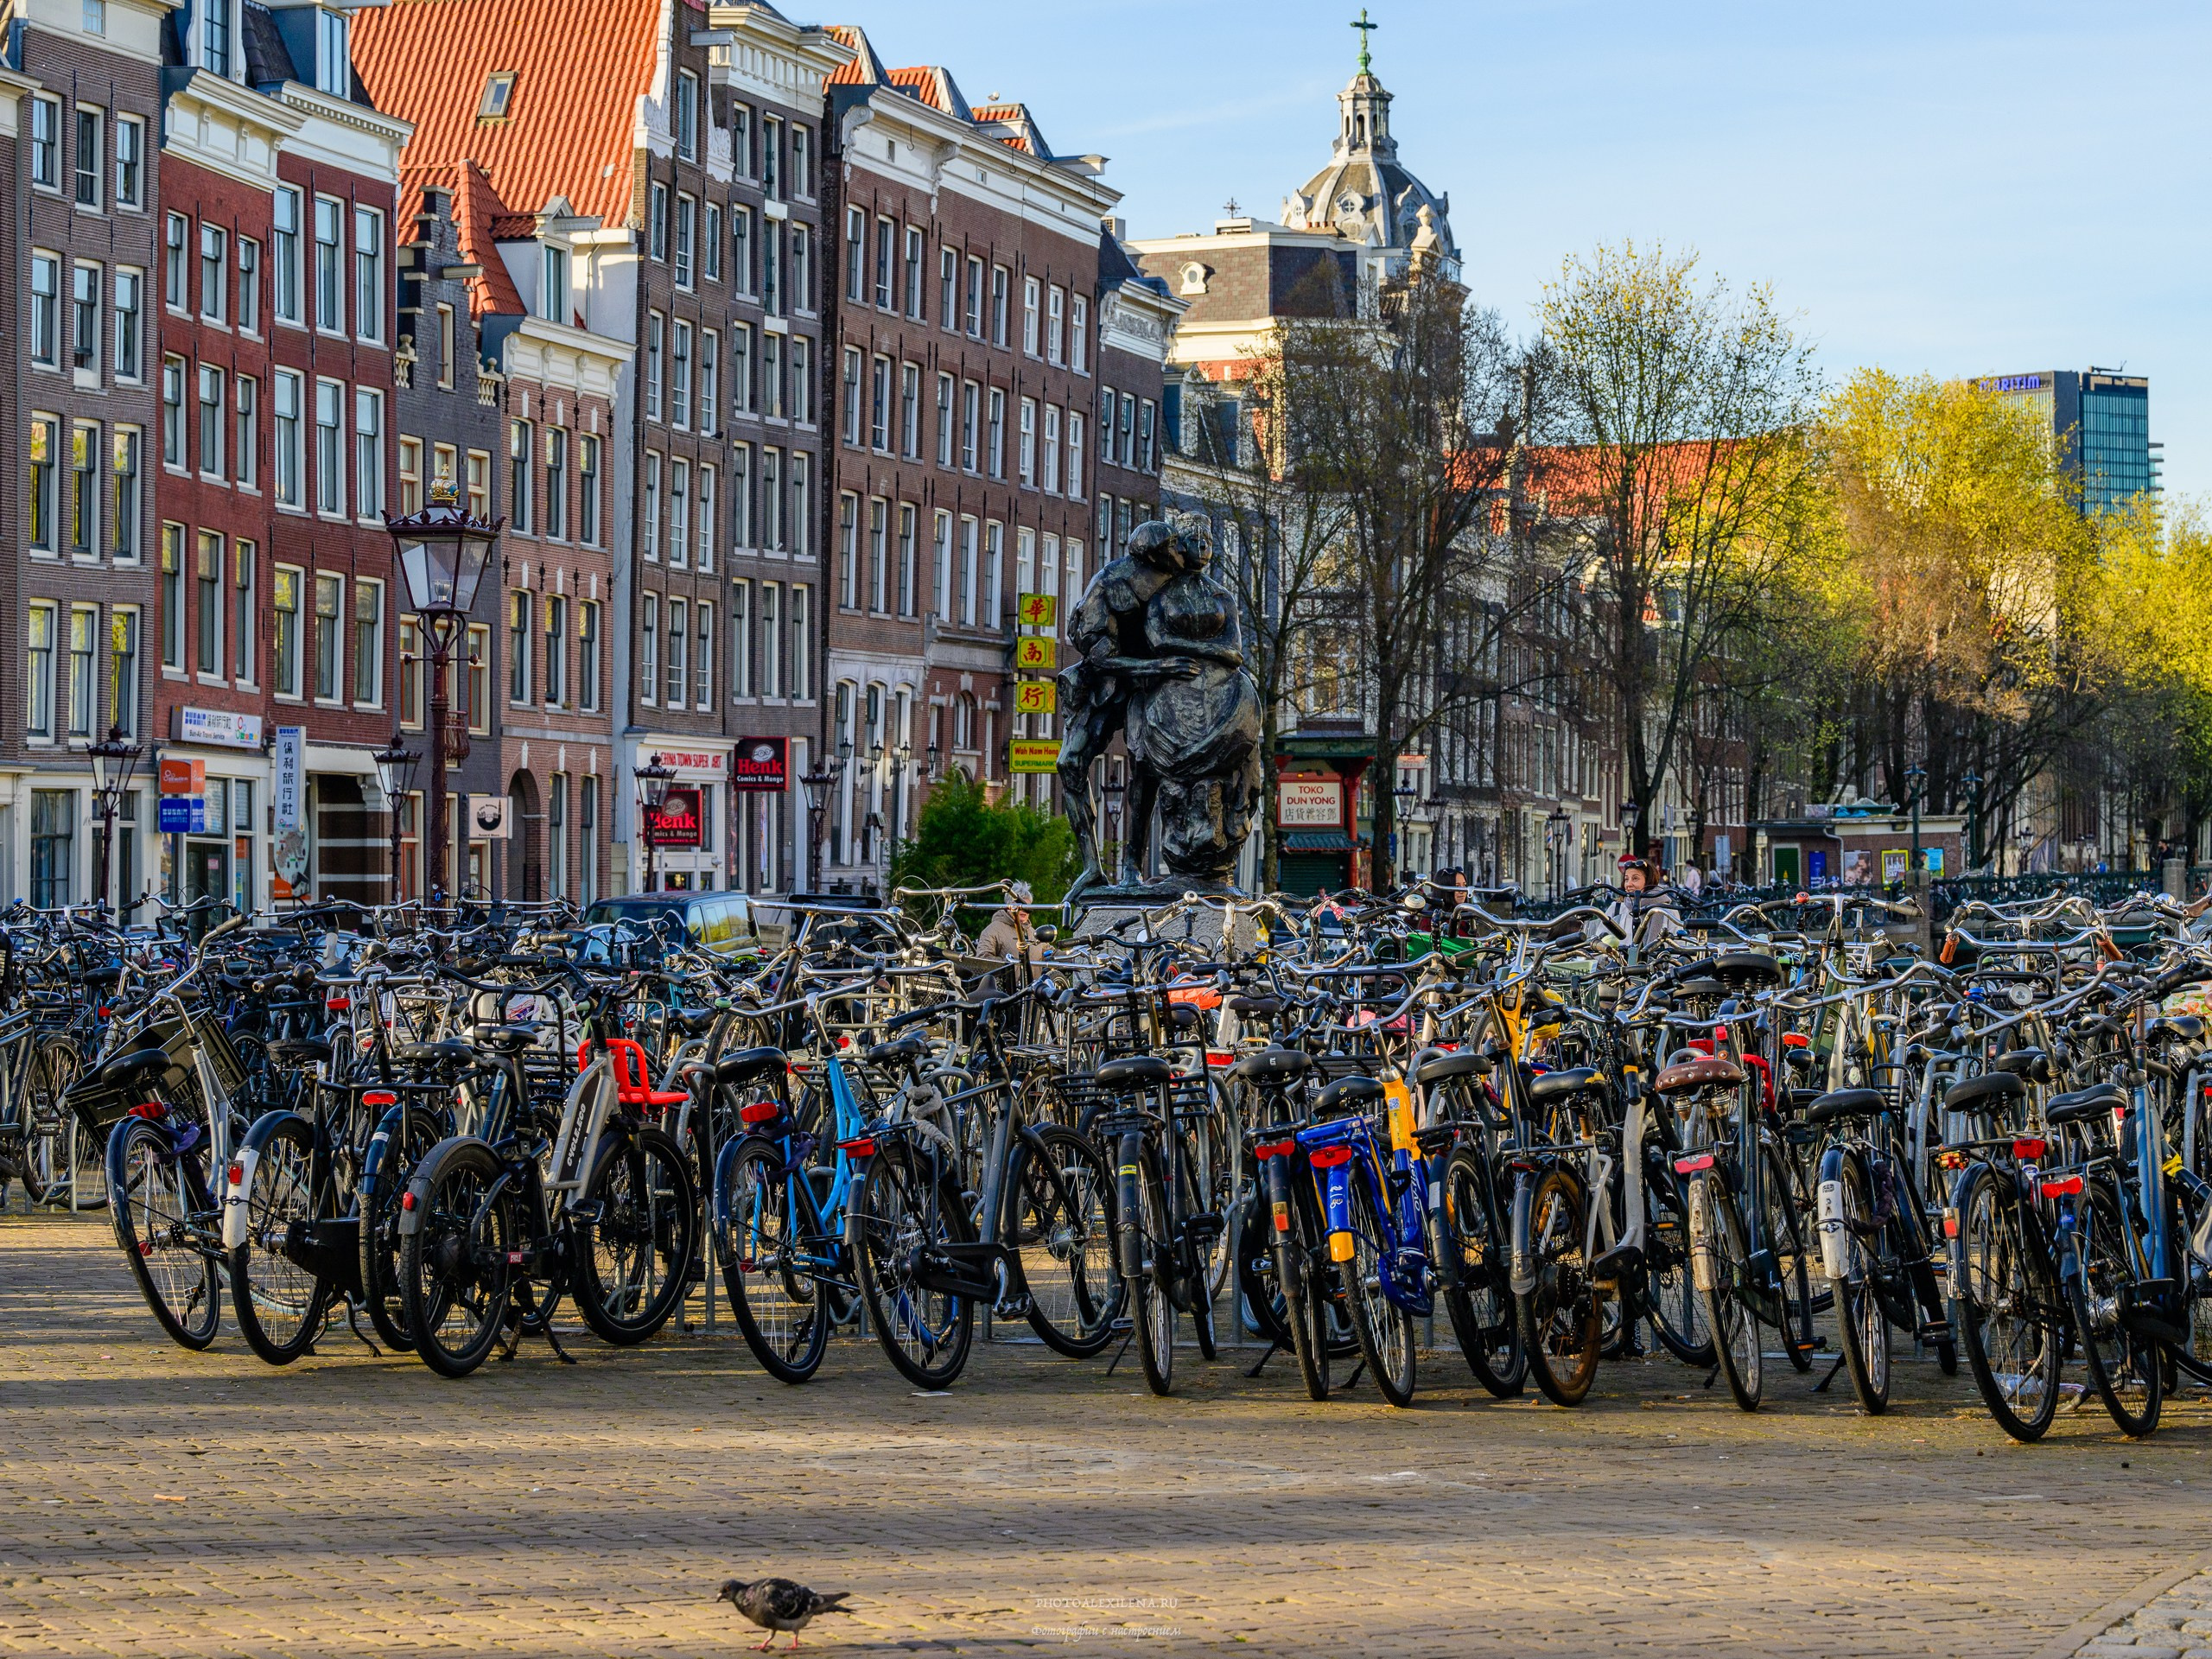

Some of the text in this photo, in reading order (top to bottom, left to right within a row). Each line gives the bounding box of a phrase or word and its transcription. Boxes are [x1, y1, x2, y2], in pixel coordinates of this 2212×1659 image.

[1025, 598, 1046, 622] 華
[1024, 642, 1042, 663] 南
[1021, 688, 1044, 707] 行
[1029, 747, 1042, 755] Nam
[661, 752, 677, 766] CHINA
[677, 753, 692, 766] TOWN
[692, 754, 709, 767] SUPER
[737, 759, 783, 775] Henk
[764, 775, 784, 784] Manga
[1298, 785, 1324, 794] TOKO
[677, 830, 697, 838] Manga
